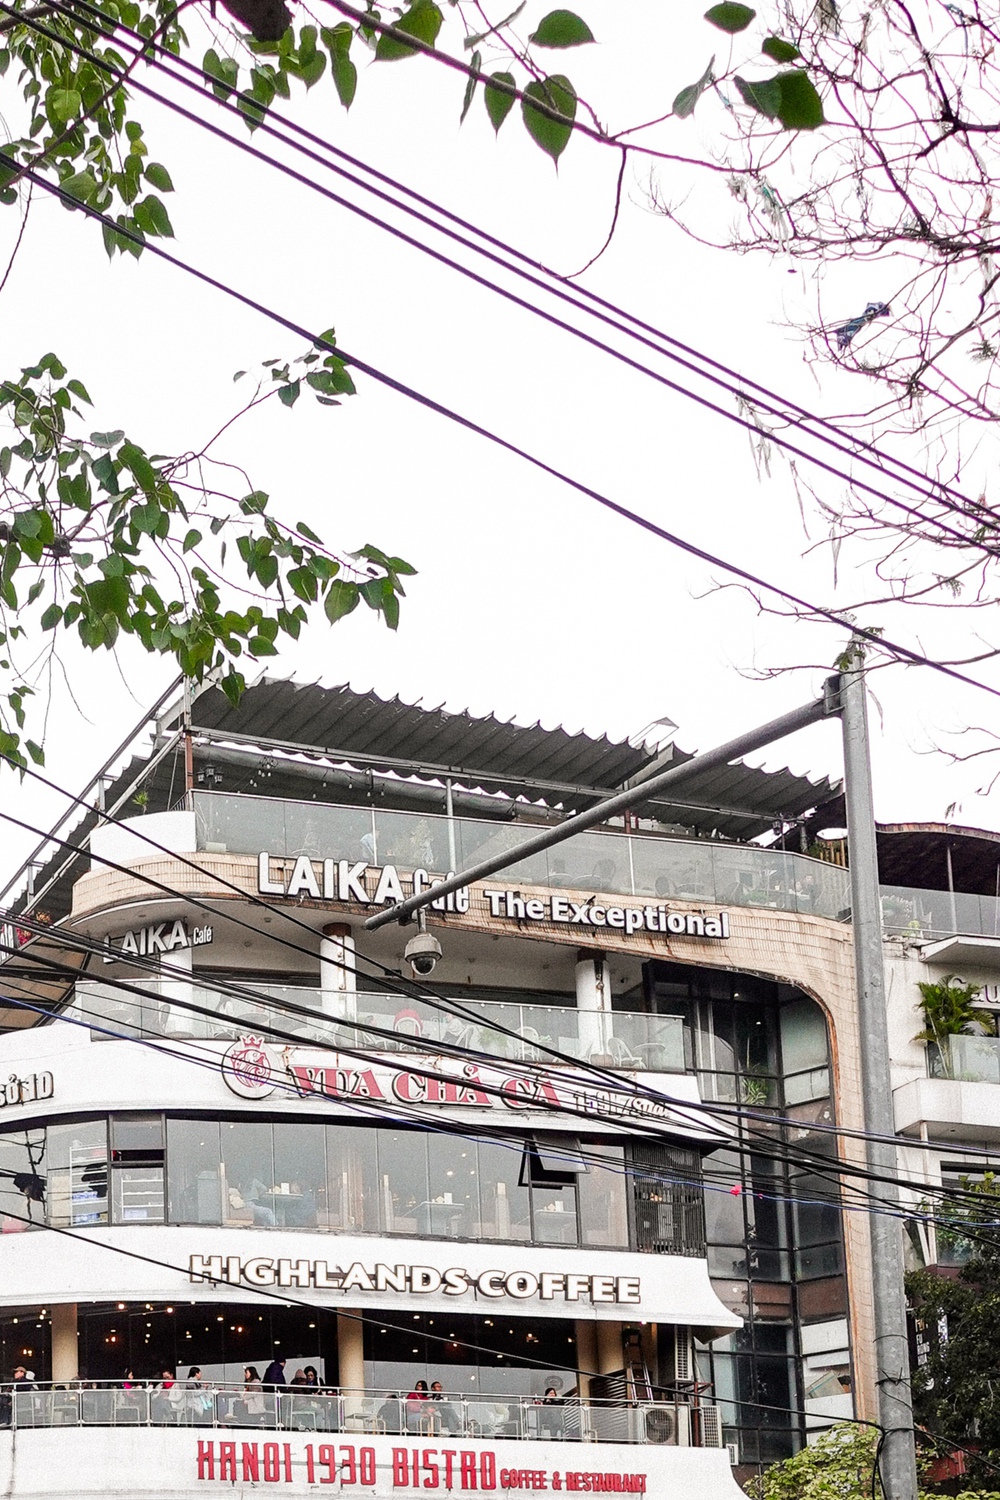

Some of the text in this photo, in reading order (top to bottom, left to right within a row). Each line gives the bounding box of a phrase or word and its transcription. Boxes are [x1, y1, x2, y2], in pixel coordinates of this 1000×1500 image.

[257, 851, 405, 905] LAIKA
[192, 925, 214, 946] Café
[483, 889, 730, 938] The Exceptional
[290, 1065, 386, 1102] VUA
[190, 1254, 641, 1304] HIGHLANDS COFFEE
[198, 1440, 648, 1493] HANOI 1930 BISTRO COFFEE & RESTAURANT
